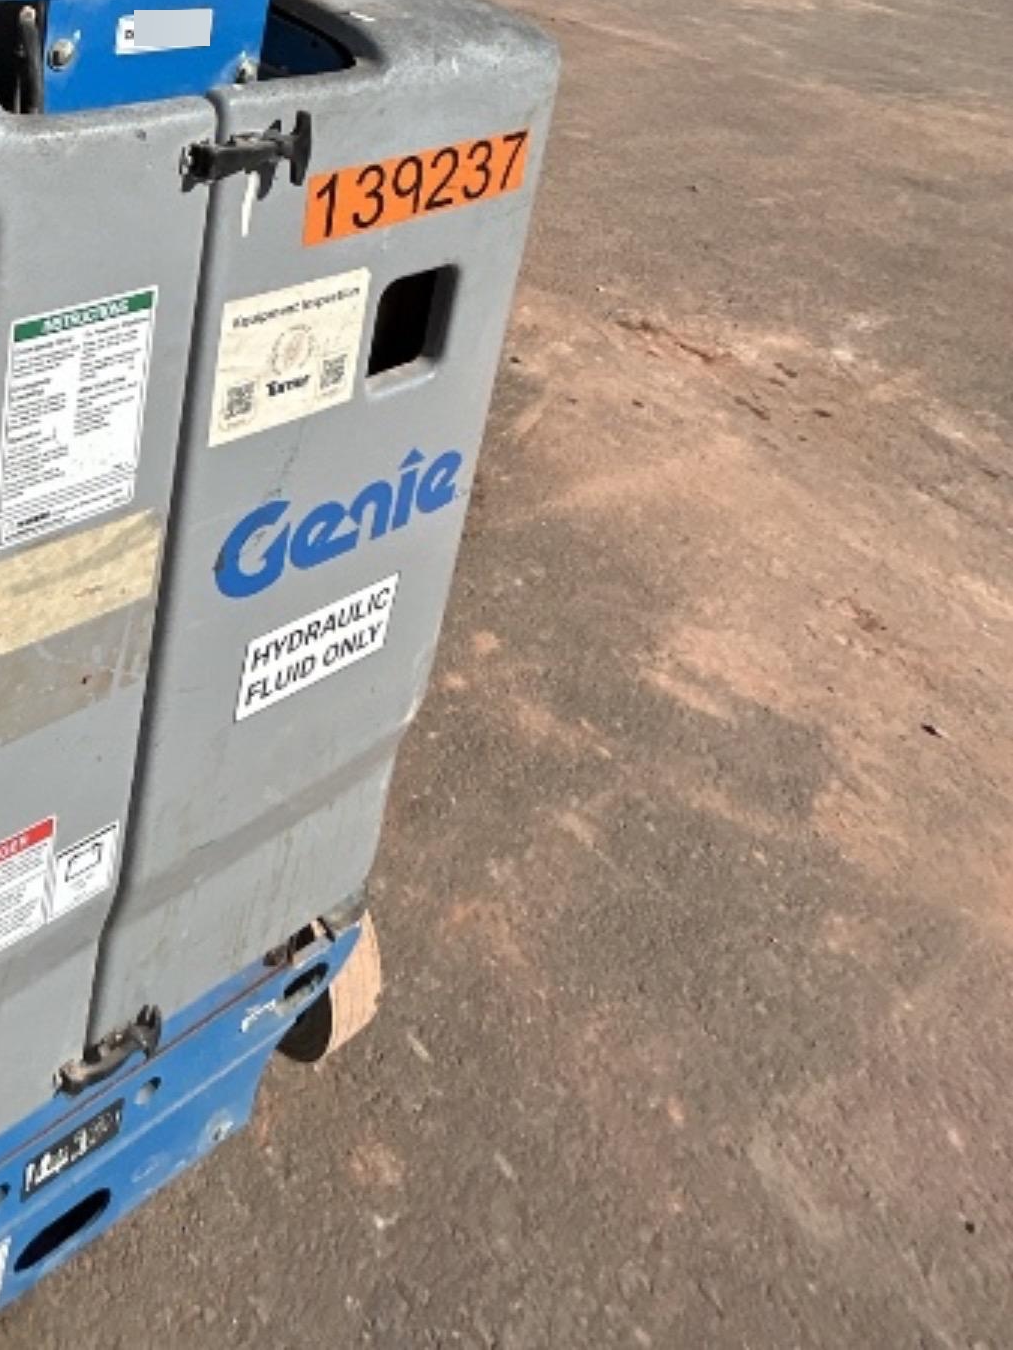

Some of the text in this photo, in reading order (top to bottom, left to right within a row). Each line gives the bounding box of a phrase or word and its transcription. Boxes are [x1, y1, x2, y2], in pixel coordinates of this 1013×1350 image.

[316, 130, 528, 238] 139237
[214, 448, 463, 598] Genie
[245, 620, 384, 706] FLUID ONLY
[251, 587, 390, 672] HYDRAULIC
